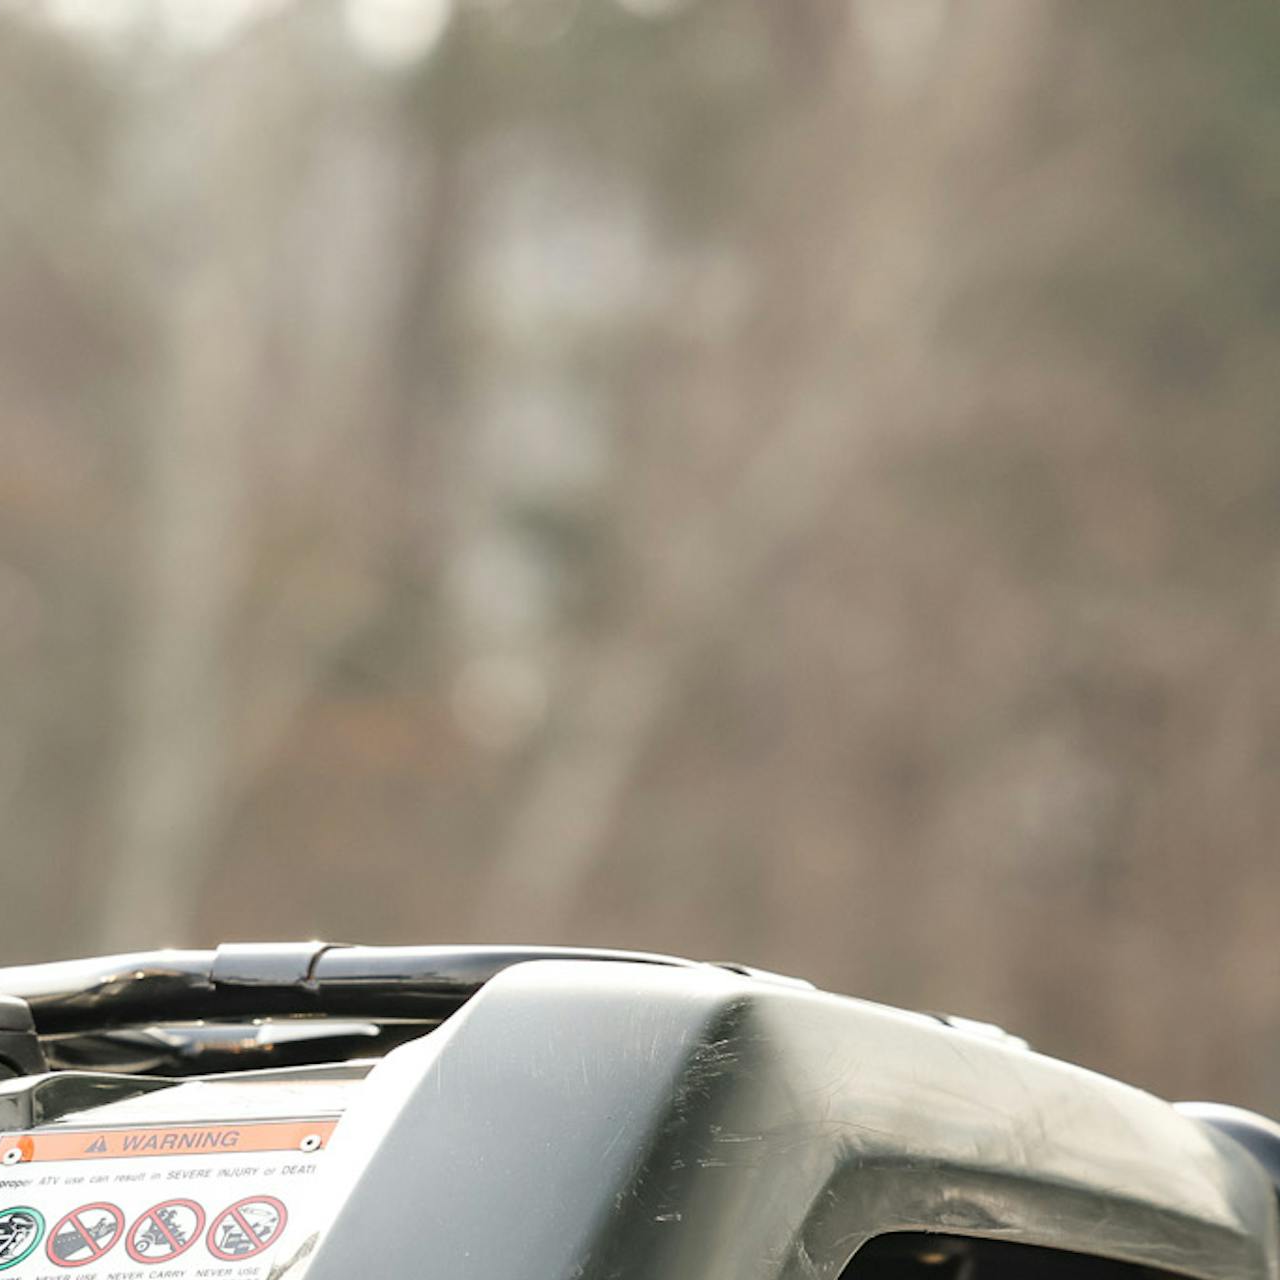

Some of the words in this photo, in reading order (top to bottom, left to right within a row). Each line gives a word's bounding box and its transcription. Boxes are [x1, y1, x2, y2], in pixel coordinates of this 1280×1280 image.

[122, 1130, 240, 1152] WARNING
[39, 1175, 60, 1185] ATV
[64, 1176, 85, 1185] use
[89, 1175, 109, 1184] can
[114, 1172, 146, 1182] result
[166, 1169, 212, 1180] SEVERE
[218, 1167, 258, 1178] INJURY
[263, 1168, 276, 1176] or
[107, 1271, 143, 1280] NEVER
[148, 1270, 185, 1279] CARRY
[196, 1268, 233, 1278] NEVER
[237, 1267, 260, 1276] USE
